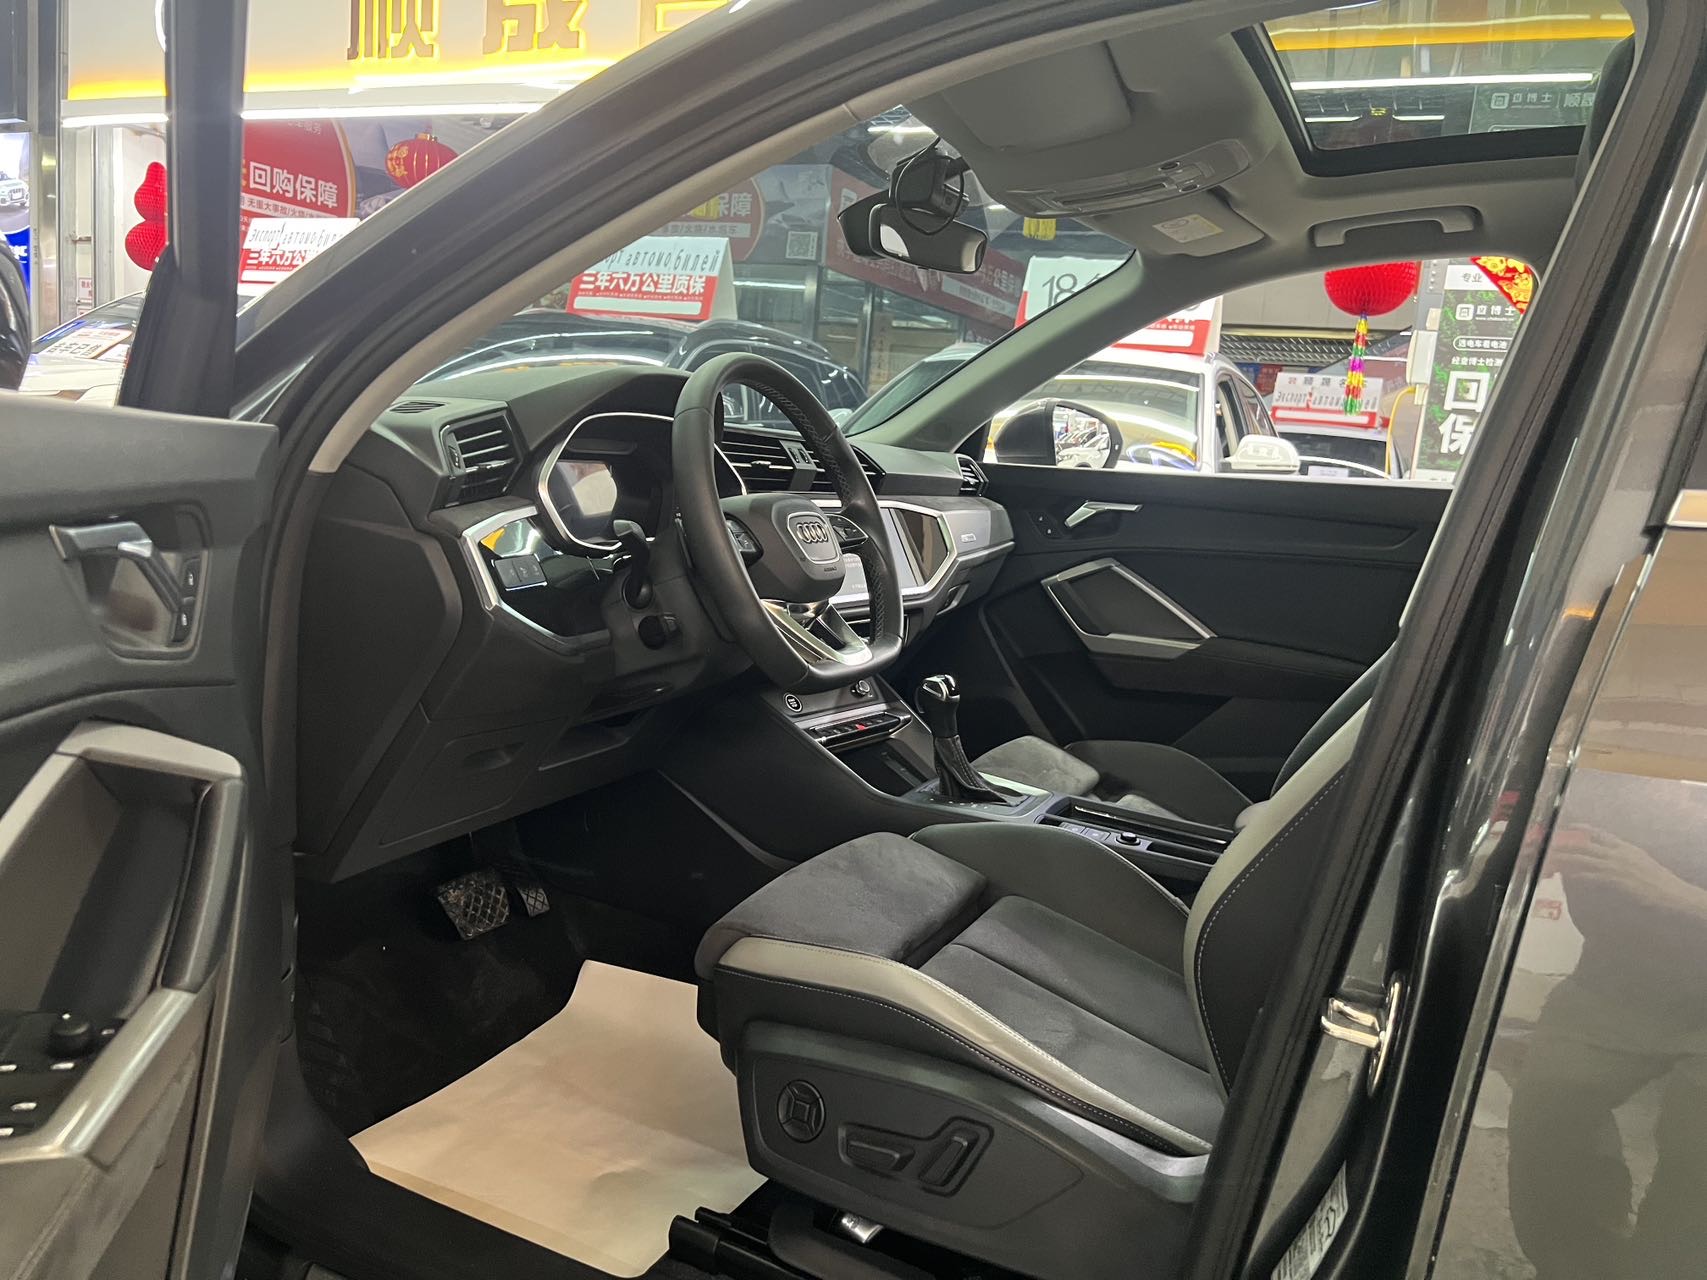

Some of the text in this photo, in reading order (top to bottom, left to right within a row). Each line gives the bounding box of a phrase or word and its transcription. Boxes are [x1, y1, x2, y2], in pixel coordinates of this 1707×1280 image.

[249, 161, 338, 209] 回购保障
[626, 249, 720, 272] автомобилей
[579, 271, 706, 295] 三年六万公里质保
